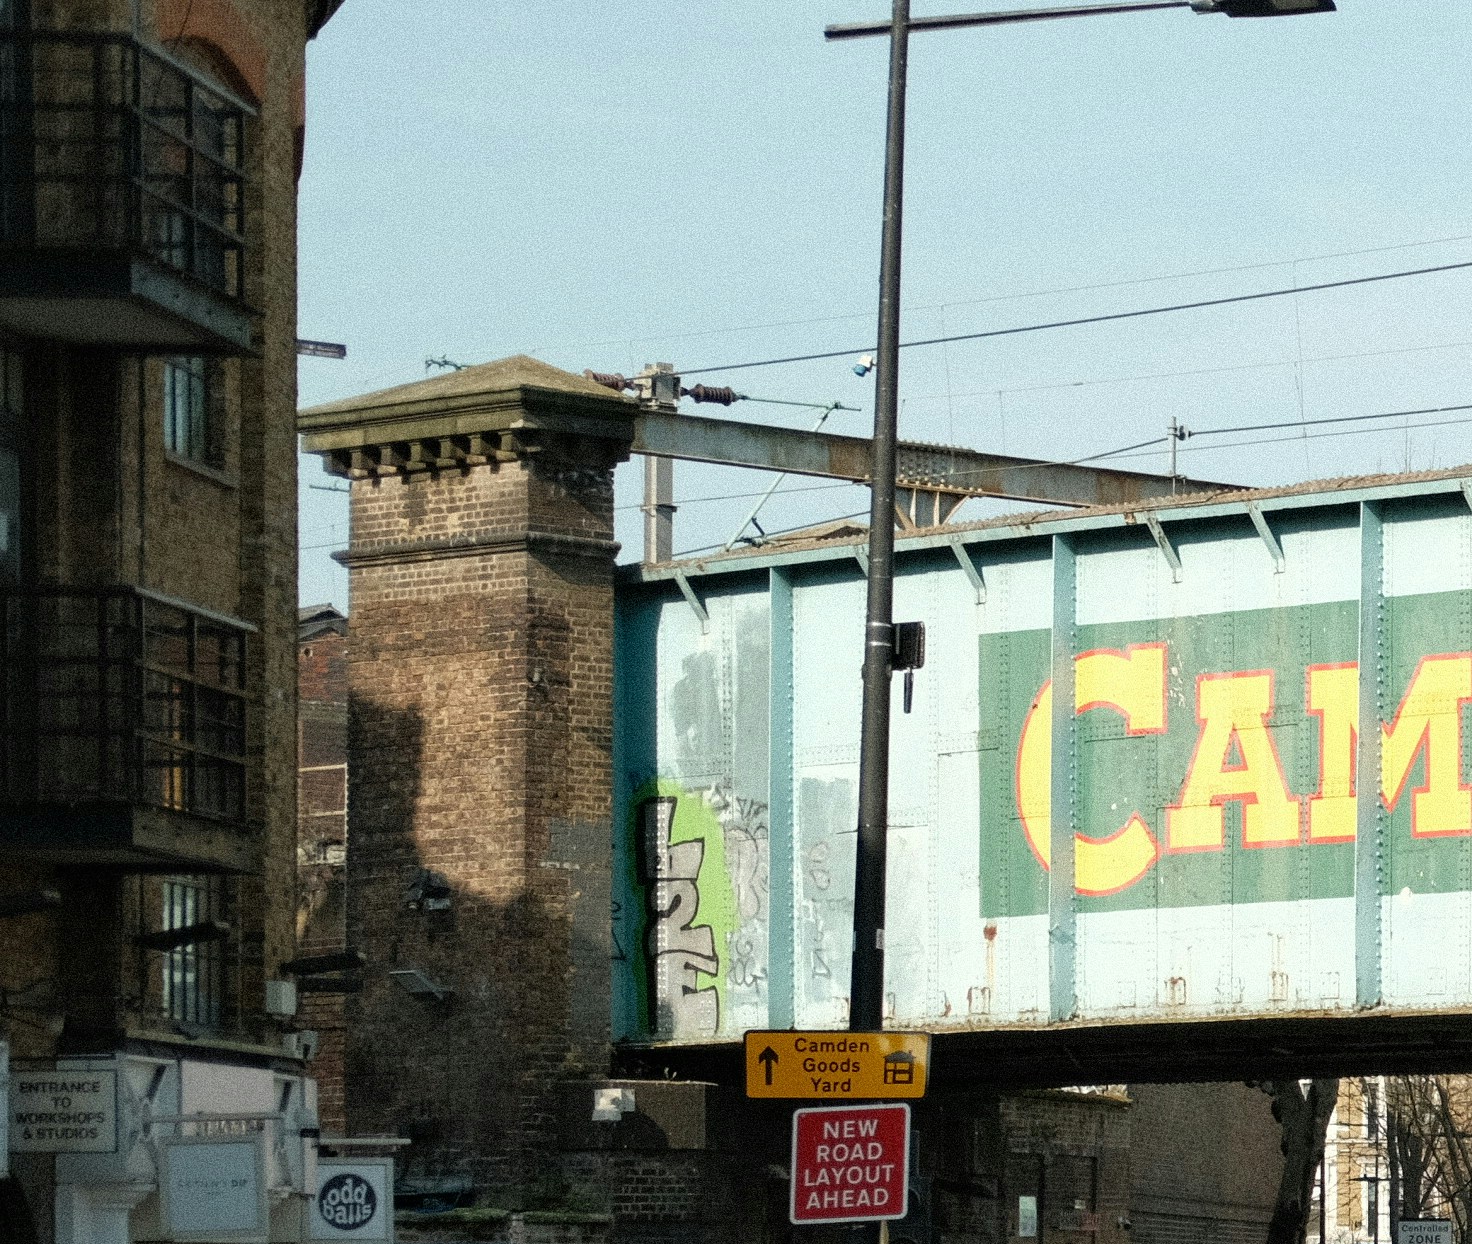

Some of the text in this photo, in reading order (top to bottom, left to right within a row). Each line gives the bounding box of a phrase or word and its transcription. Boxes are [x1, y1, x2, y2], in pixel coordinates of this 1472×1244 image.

[794, 1037, 870, 1053] Camden
[802, 1058, 861, 1073] Goods
[18, 1081, 101, 1093] ENTRANCE
[811, 1077, 852, 1093] Yard
[53, 1097, 72, 1107] TO
[15, 1112, 105, 1124] WORKSHOPS
[22, 1127, 98, 1139] & STUDIOS
[823, 1119, 879, 1139] NEW
[816, 1142, 883, 1163] ROAD
[804, 1164, 895, 1187] LAYOUT
[327, 1178, 367, 1206] odd
[805, 1188, 889, 1210] AHEAD
[323, 1200, 372, 1225] balls
[1401, 1224, 1449, 1233] Controlled
[1408, 1234, 1441, 1244] ZONE
